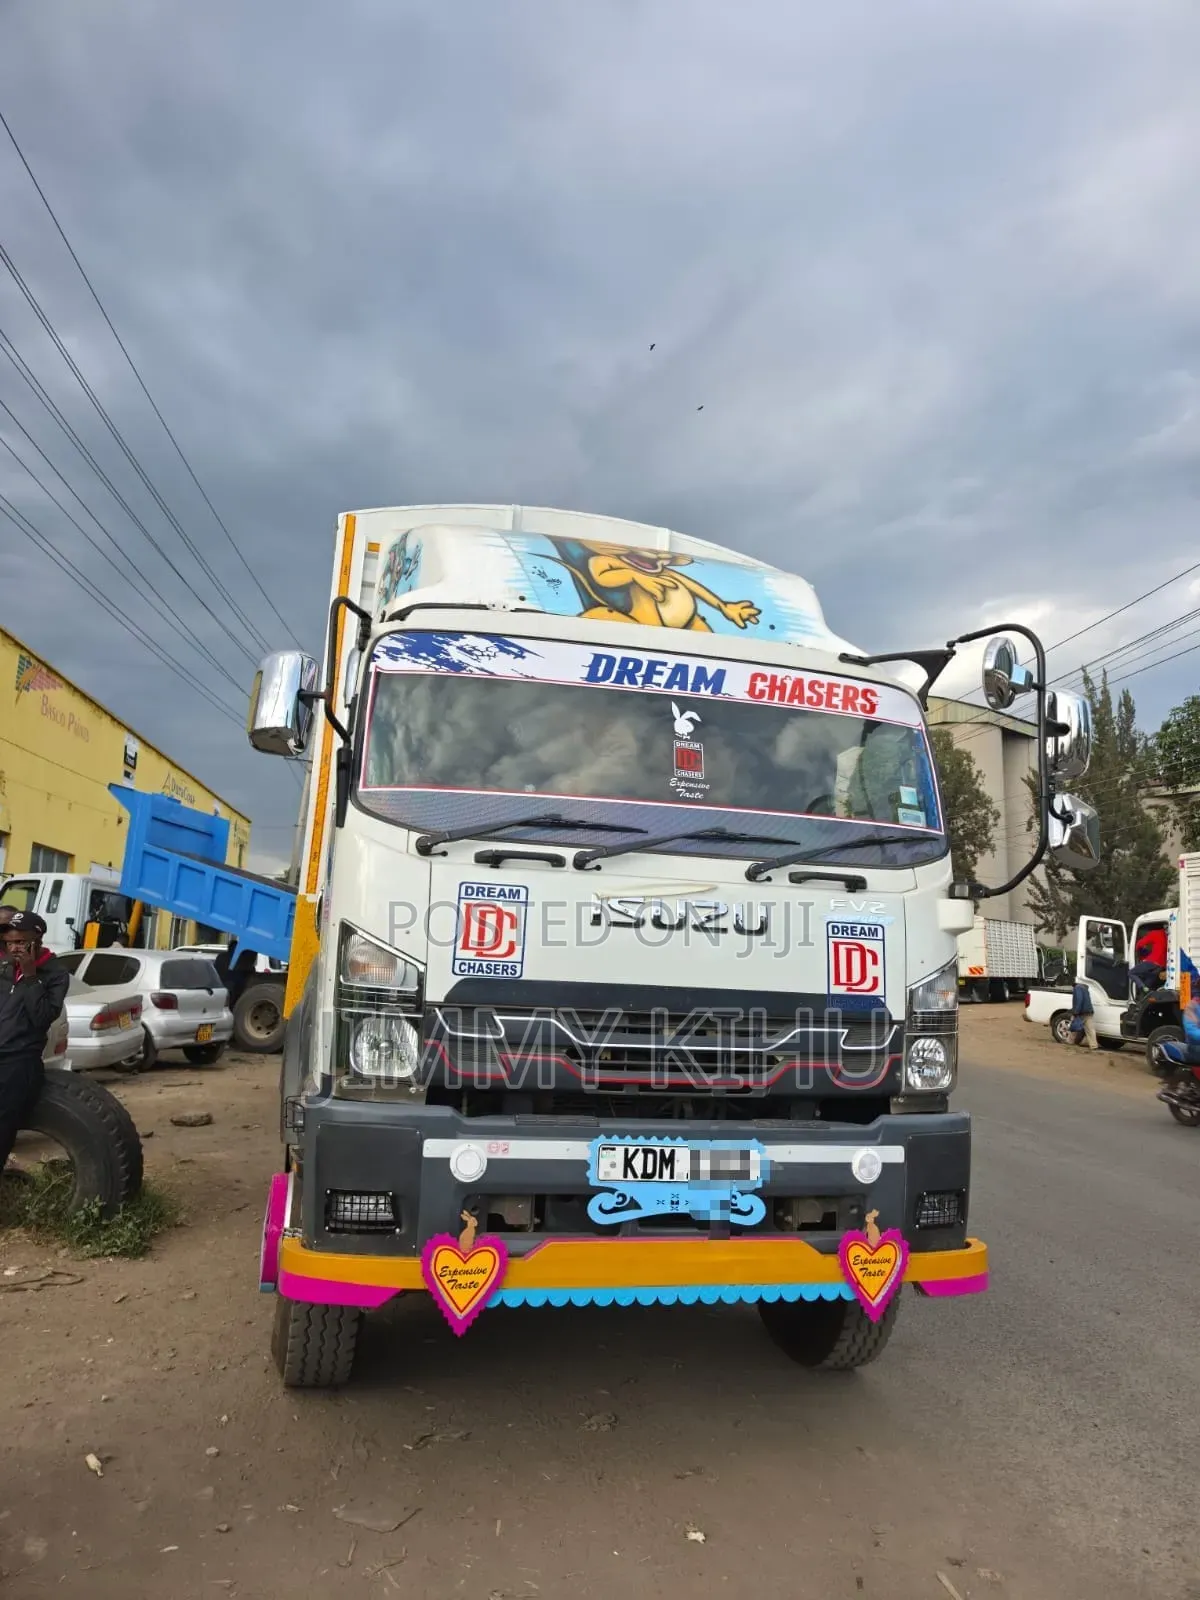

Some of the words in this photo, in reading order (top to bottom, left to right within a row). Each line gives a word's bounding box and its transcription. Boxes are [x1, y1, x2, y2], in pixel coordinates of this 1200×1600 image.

[582, 653, 729, 696] DREAM
[746, 671, 881, 715] CHASERS
[676, 741, 700, 749] DREAM
[669, 777, 711, 790] Expensive
[676, 788, 705, 799] Taste
[464, 885, 521, 900] DREAM
[590, 892, 769, 936] ISUZU
[831, 925, 879, 938] DREAM
[458, 962, 518, 976] CHASERS
[623, 1147, 676, 1180] KDM
[853, 1254, 892, 1266] Expensive
[439, 1265, 488, 1279] Expensive
[859, 1267, 885, 1278] Taste
[446, 1279, 479, 1290] Taste
